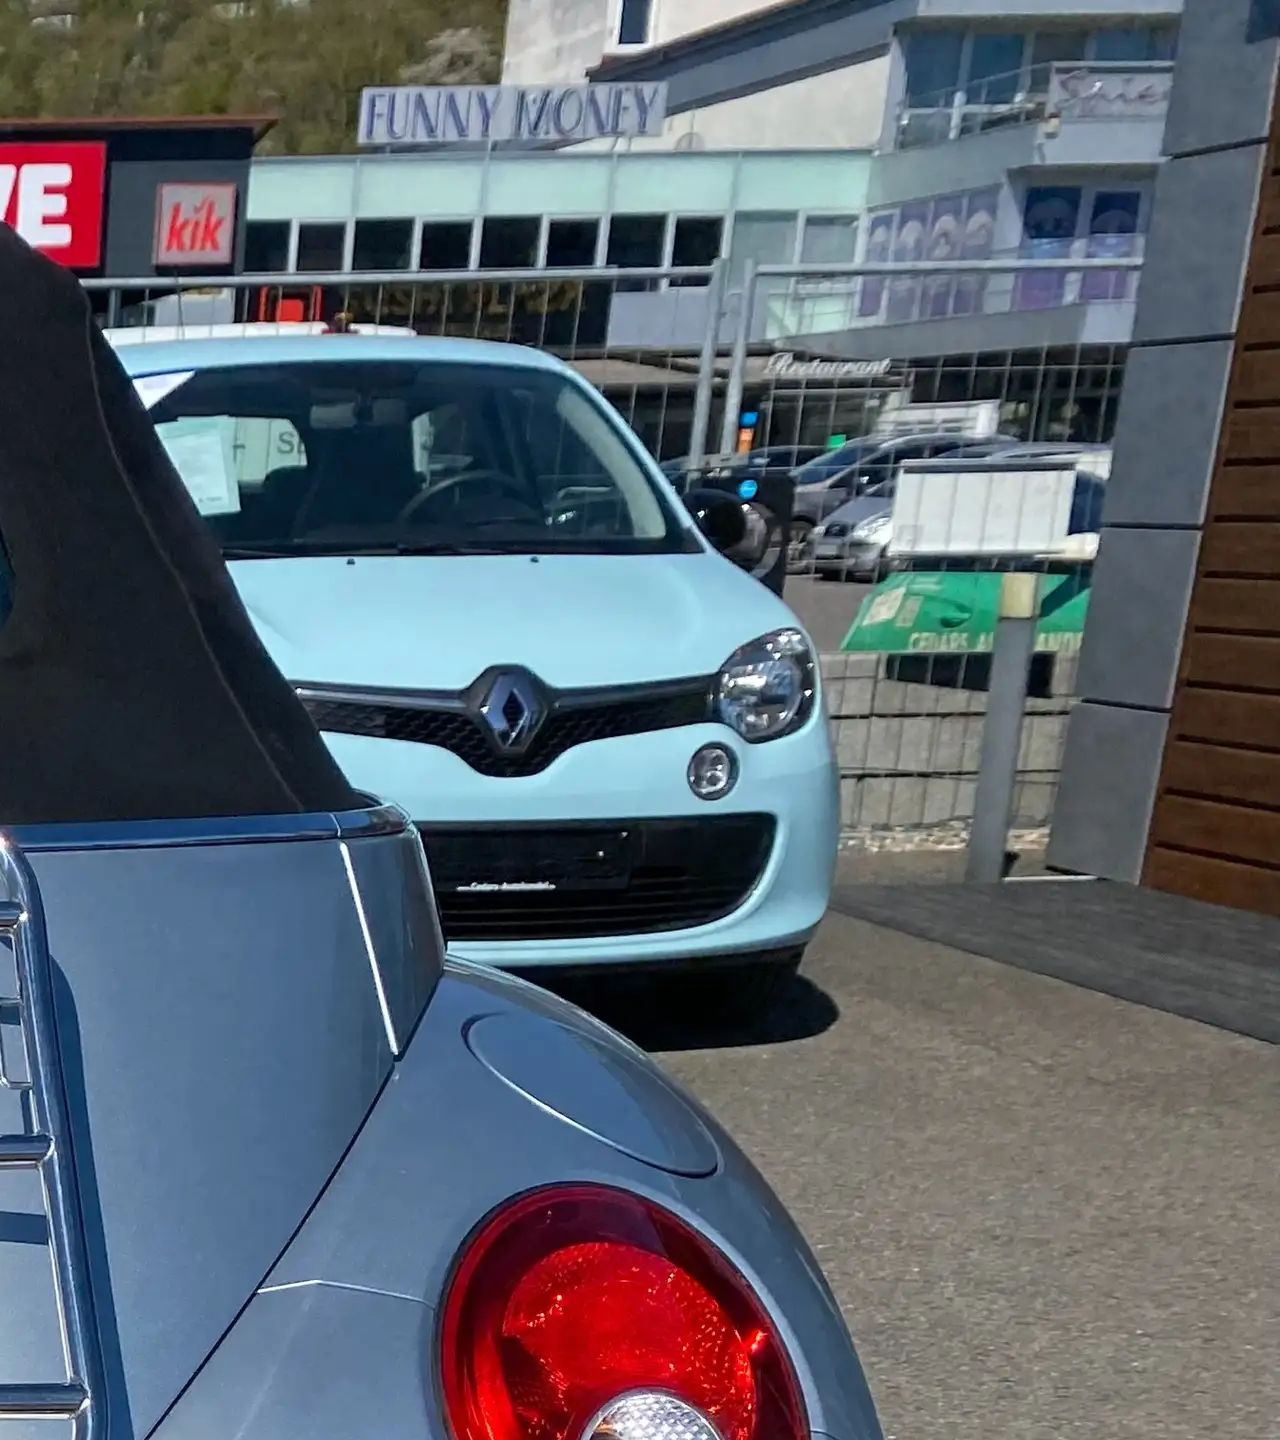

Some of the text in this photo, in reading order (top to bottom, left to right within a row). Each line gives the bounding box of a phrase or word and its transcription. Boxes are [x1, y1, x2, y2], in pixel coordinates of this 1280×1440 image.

[366, 85, 659, 140] FUNNY MONEY
[165, 194, 225, 253] kik
